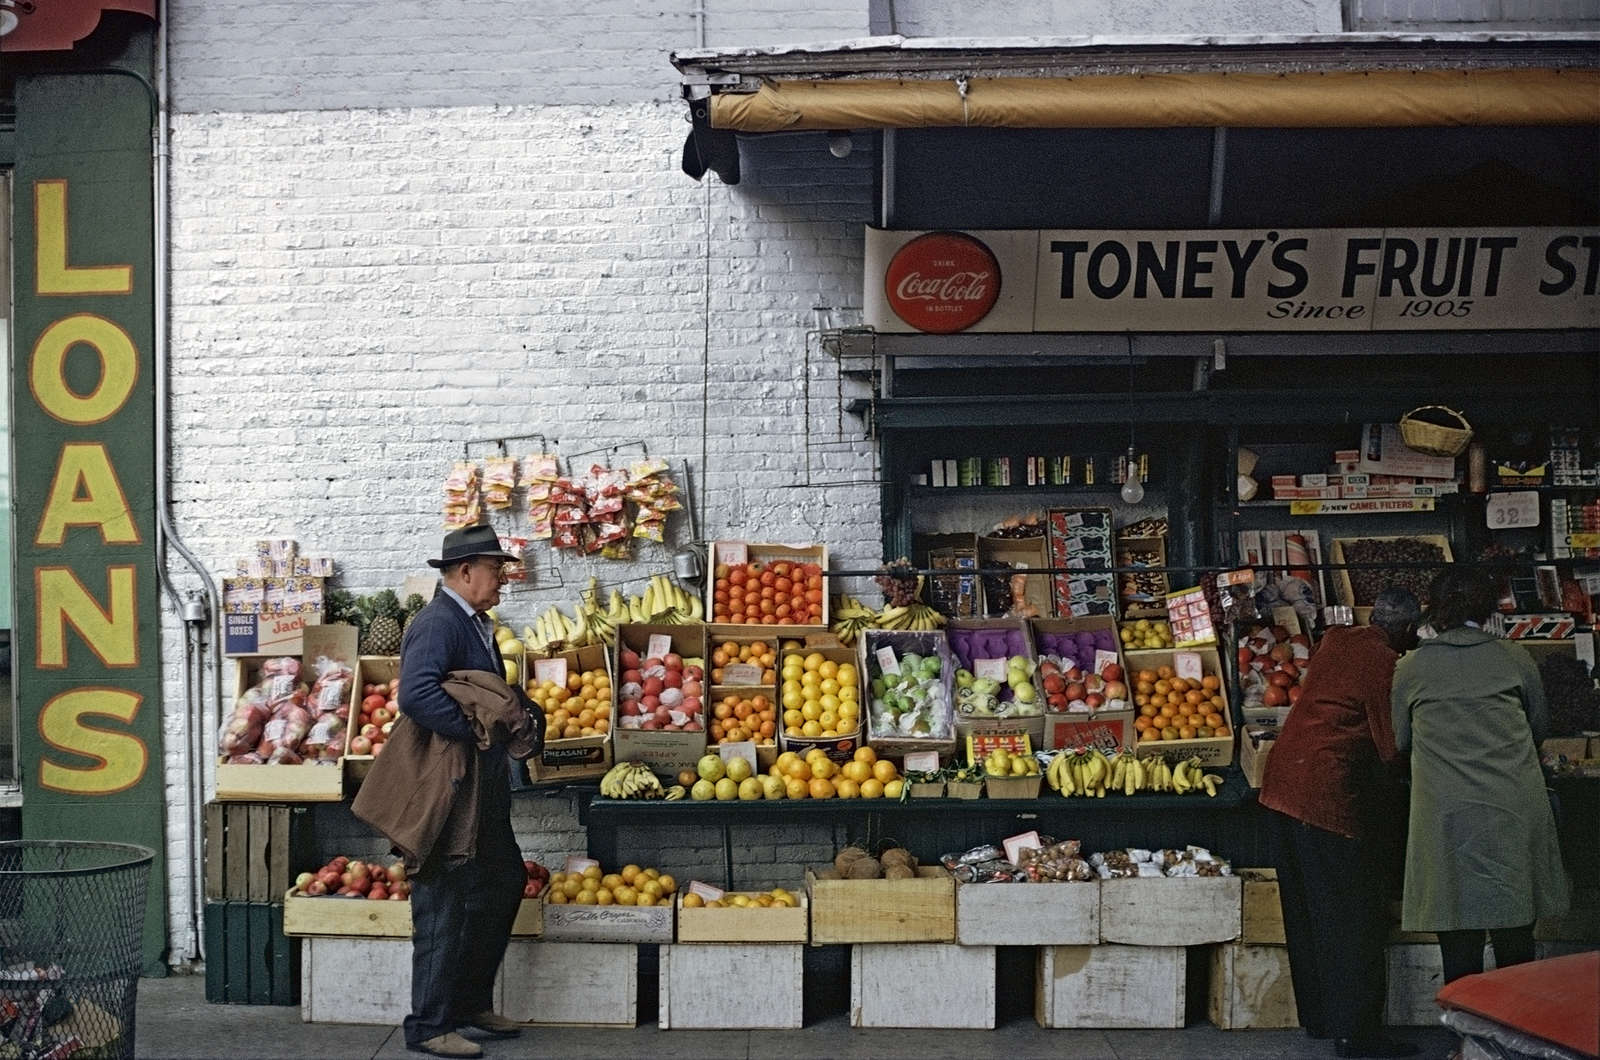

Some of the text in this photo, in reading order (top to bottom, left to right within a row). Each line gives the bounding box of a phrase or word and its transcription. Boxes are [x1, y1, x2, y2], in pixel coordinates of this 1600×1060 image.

[1050, 230, 1309, 299] TONEY'S
[1341, 236, 1518, 298] FRUIT
[896, 271, 990, 301] Coca-Cola
[1267, 299, 1475, 320] Since 1905
[28, 179, 148, 796] LOANS
[1349, 501, 1377, 510] CAMEL
[1379, 500, 1414, 509] FILTERS
[228, 615, 254, 625] SINGLE
[272, 616, 307, 634] Jack
[229, 626, 253, 635] BOXES
